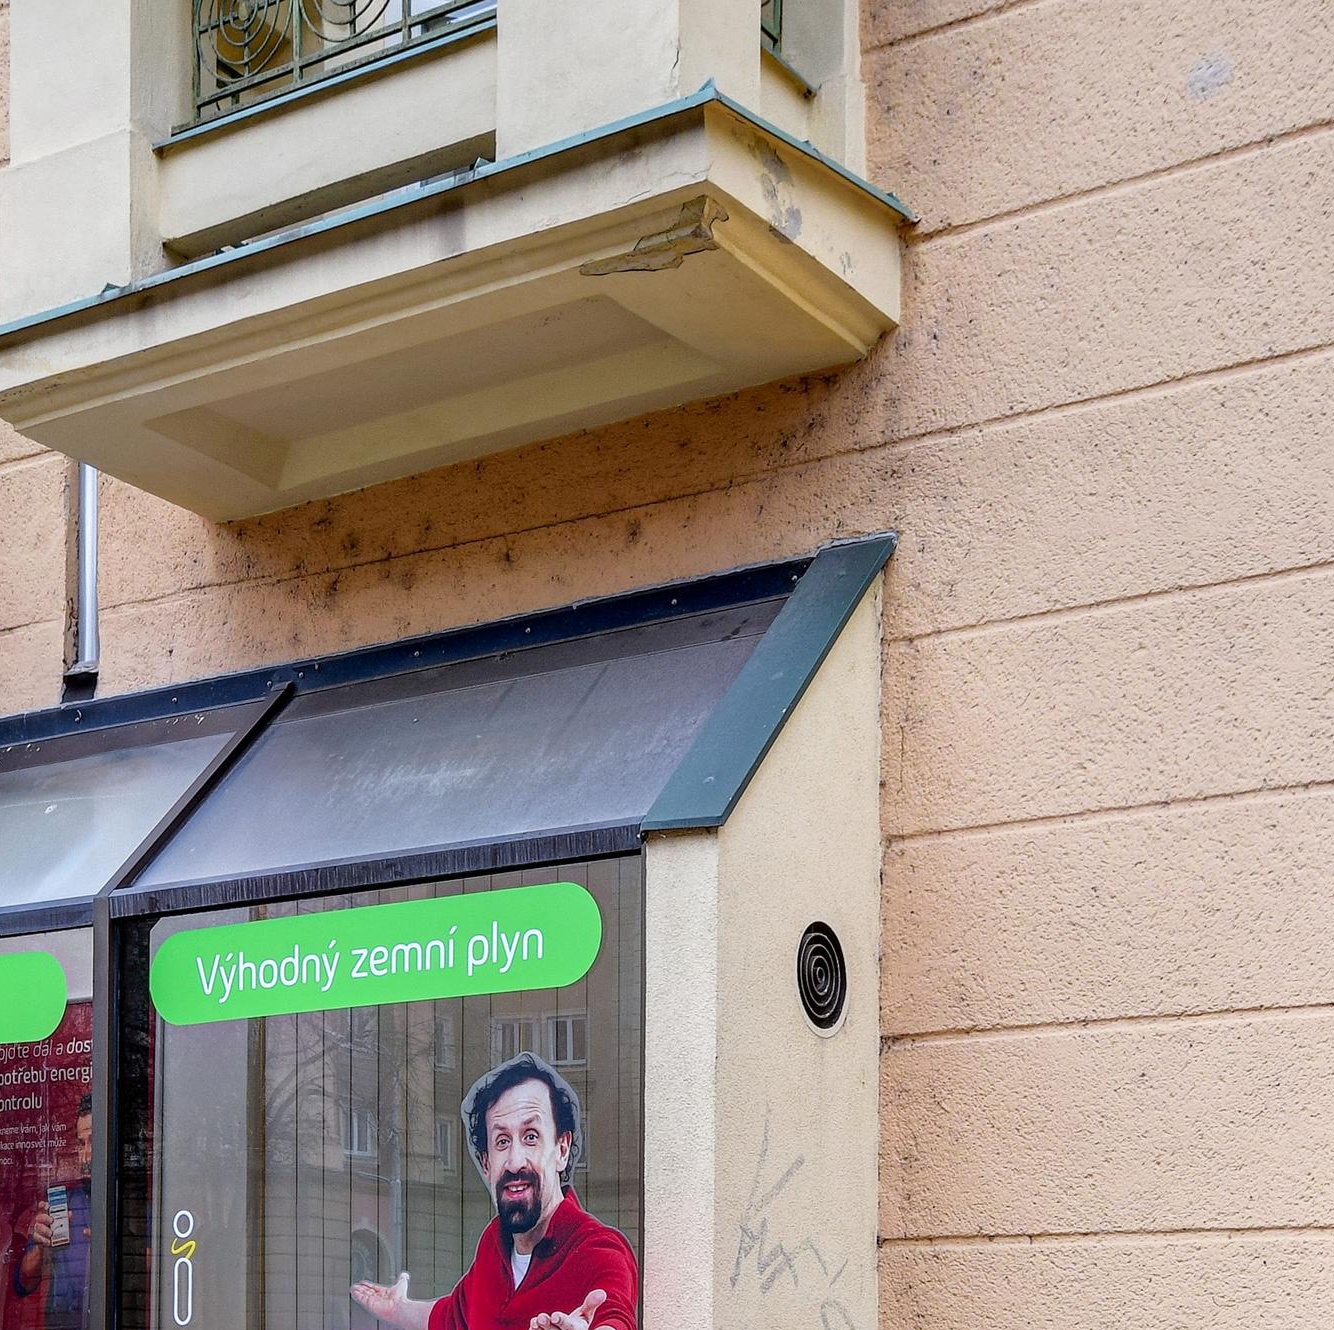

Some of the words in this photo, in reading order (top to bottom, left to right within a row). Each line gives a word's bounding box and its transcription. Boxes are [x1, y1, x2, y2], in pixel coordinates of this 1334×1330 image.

[196, 939, 340, 1004] Výhodný
[351, 925, 458, 978] zemní
[468, 921, 544, 977] plyn
[55, 1042, 64, 1056] a
